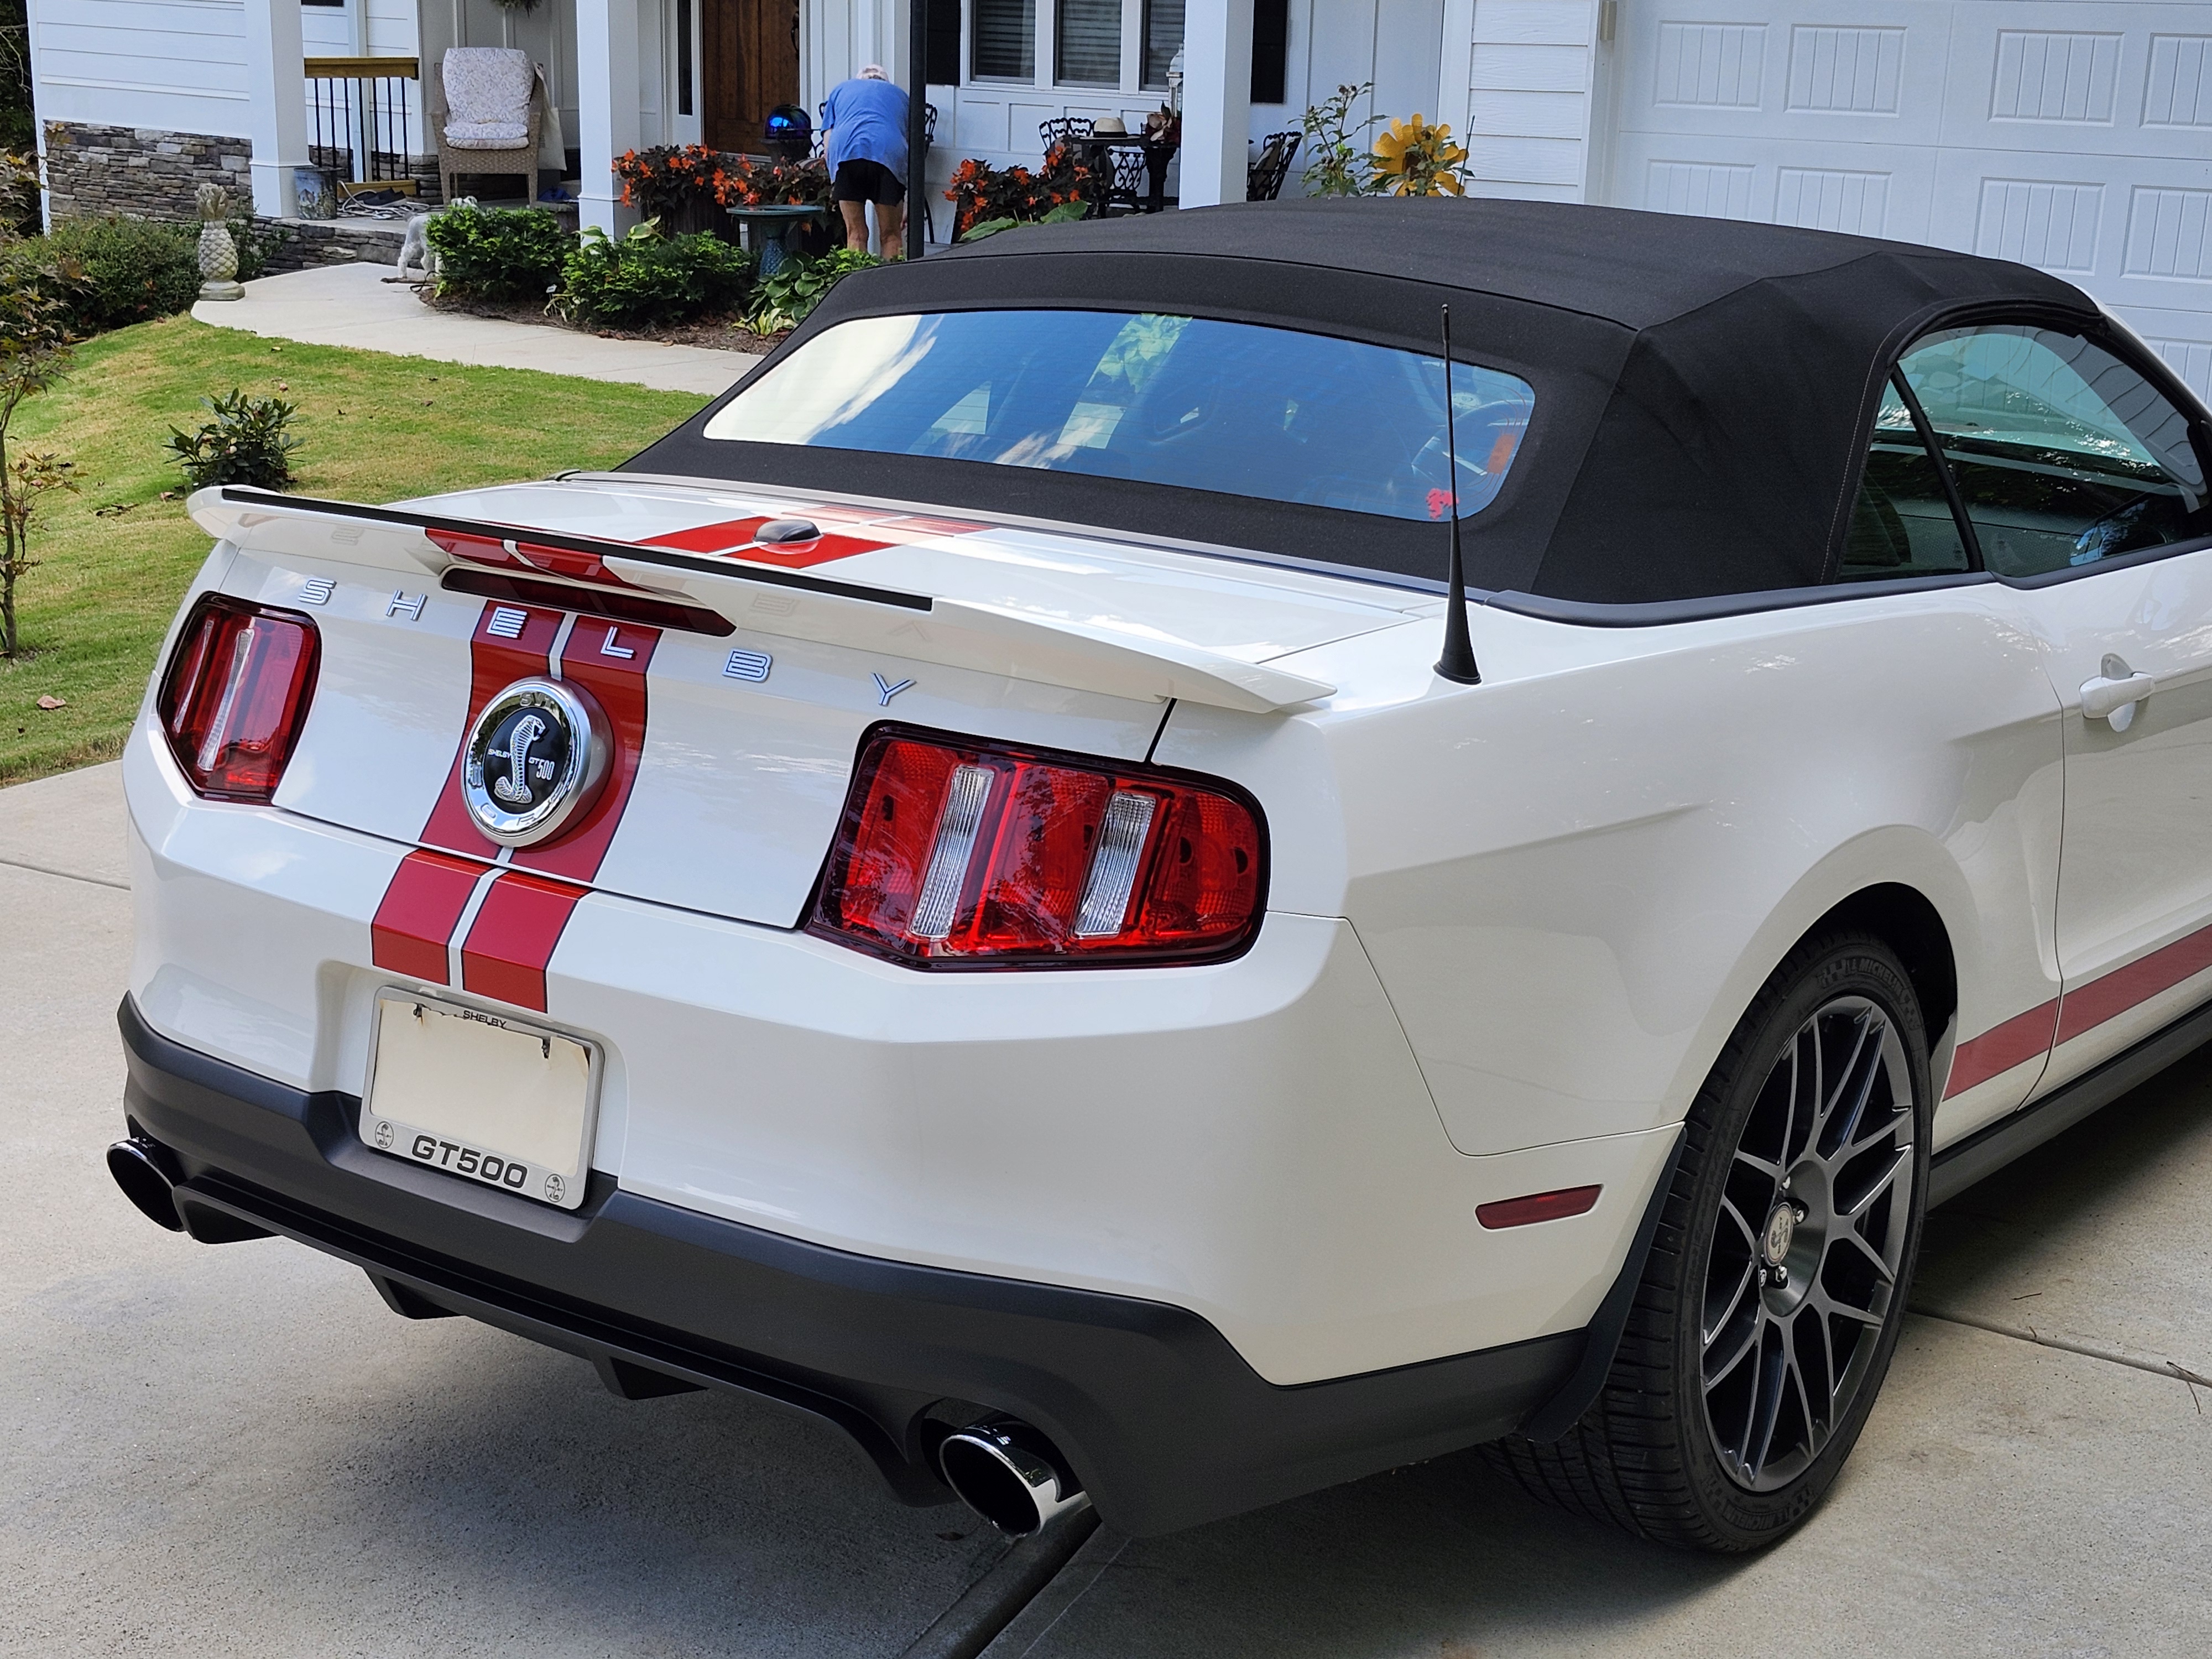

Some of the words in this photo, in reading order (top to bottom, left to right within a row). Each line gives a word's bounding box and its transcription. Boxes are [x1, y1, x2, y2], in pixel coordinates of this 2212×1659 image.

[298, 577, 916, 707] SHELBY
[520, 692, 555, 707] SVT
[463, 1010, 507, 1029] SHELBY
[412, 1135, 528, 1188] GT500
